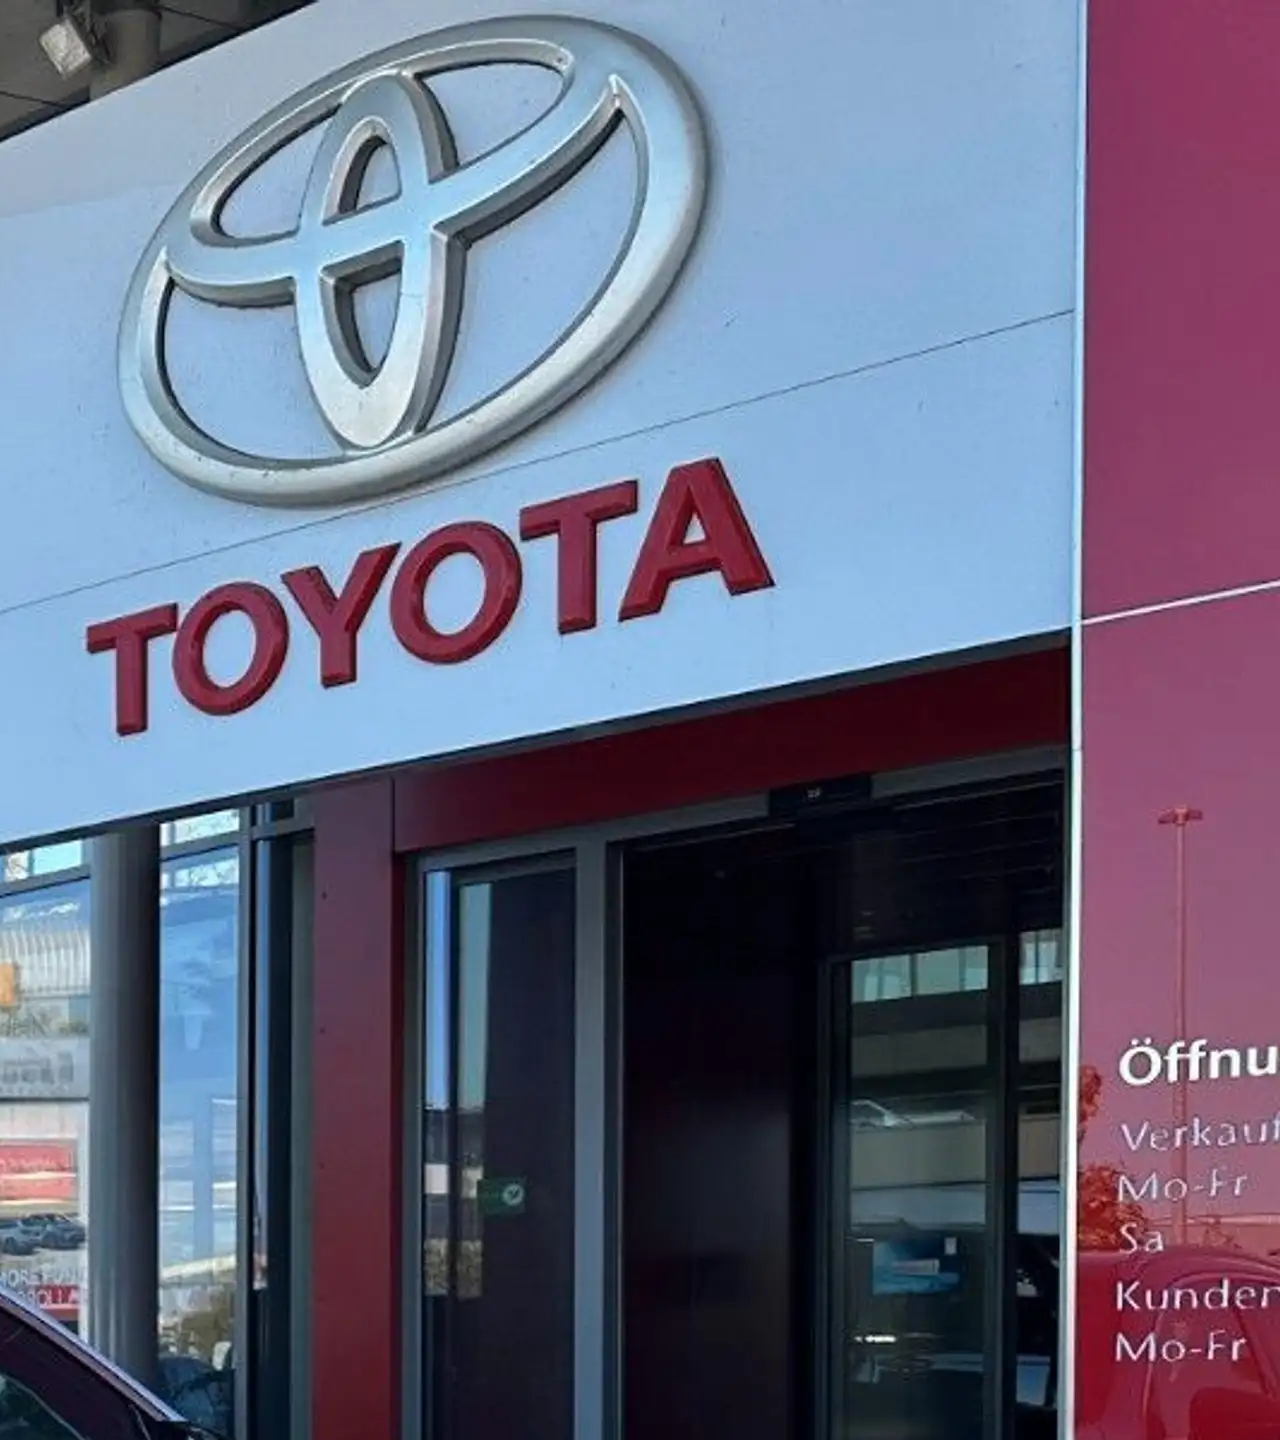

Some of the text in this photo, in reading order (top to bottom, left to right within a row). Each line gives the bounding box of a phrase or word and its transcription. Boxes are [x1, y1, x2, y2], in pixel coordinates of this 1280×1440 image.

[86, 456, 775, 737] TOYOTA
[1119, 1038, 1279, 1087] Öffnu
[1117, 1169, 1248, 1201] Mo-Fr
[1118, 1223, 1163, 1255] Sa
[1114, 1333, 1247, 1363] Mo-Fr
